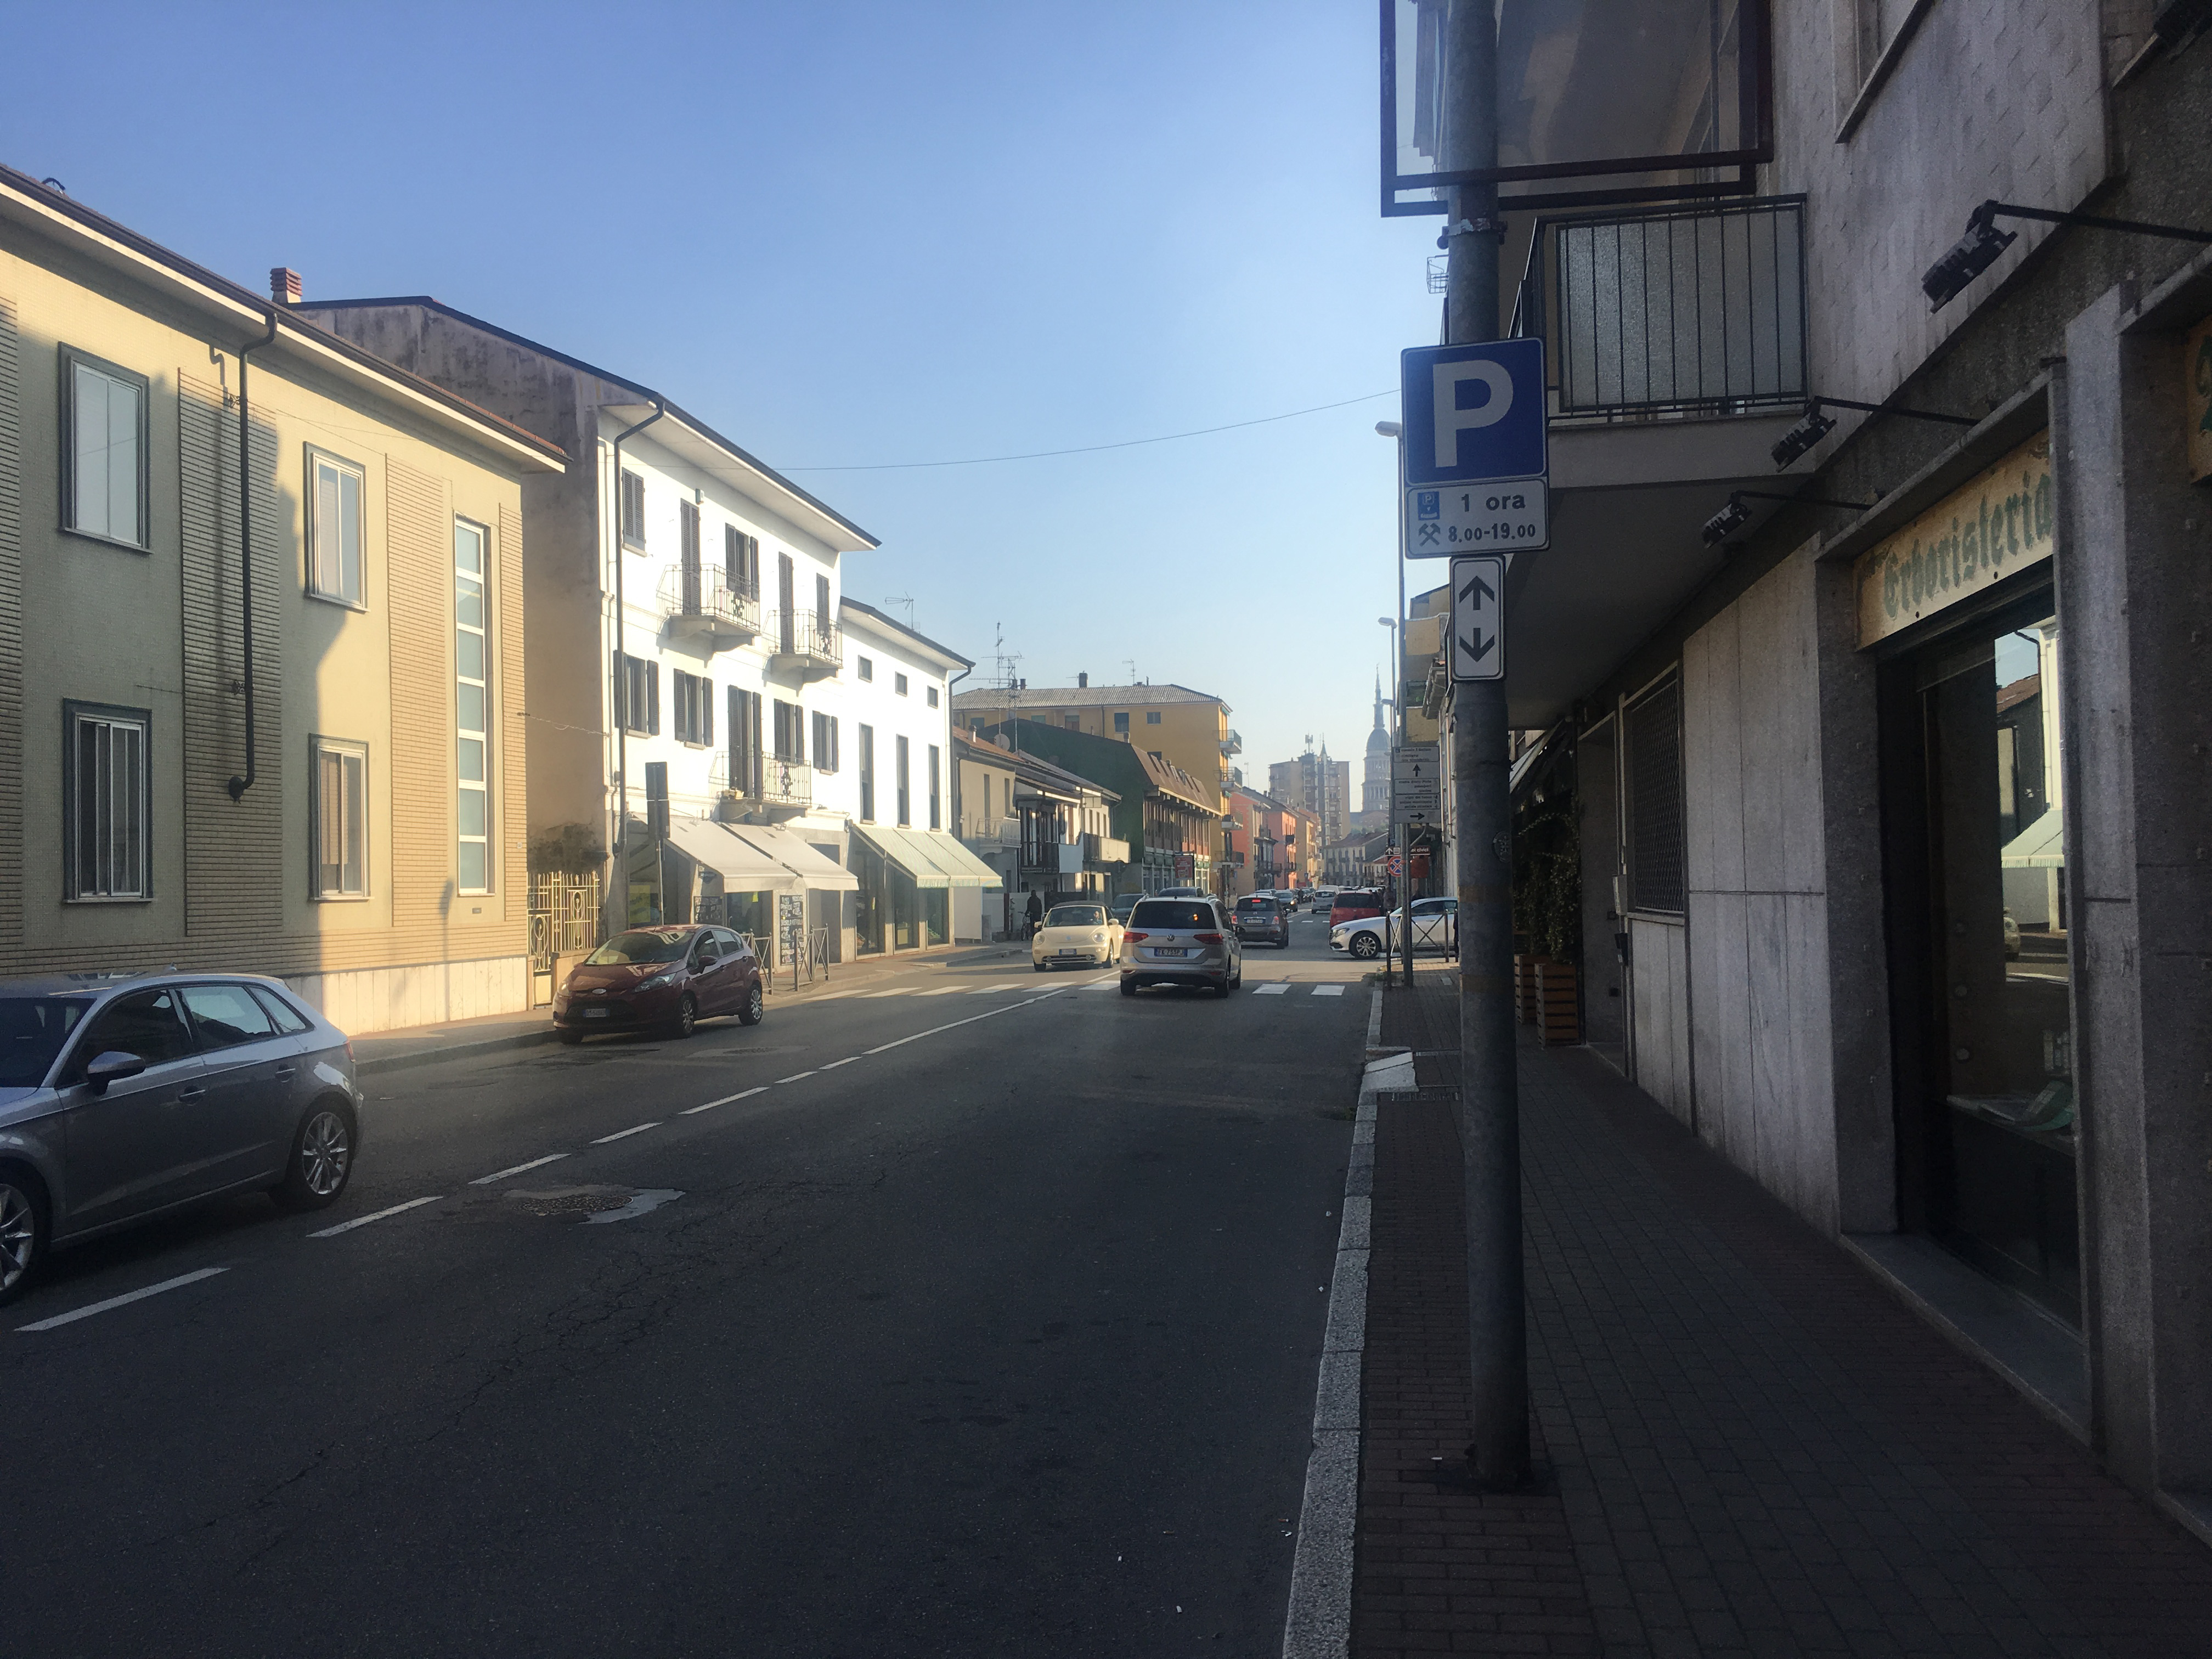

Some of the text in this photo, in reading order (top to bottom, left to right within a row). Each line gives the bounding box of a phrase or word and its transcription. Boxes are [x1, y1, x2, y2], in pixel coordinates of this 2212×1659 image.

[1432, 360, 1514, 468] P
[1461, 493, 1526, 512] 1 ora
[1448, 522, 1536, 543] 8.00-19.00
